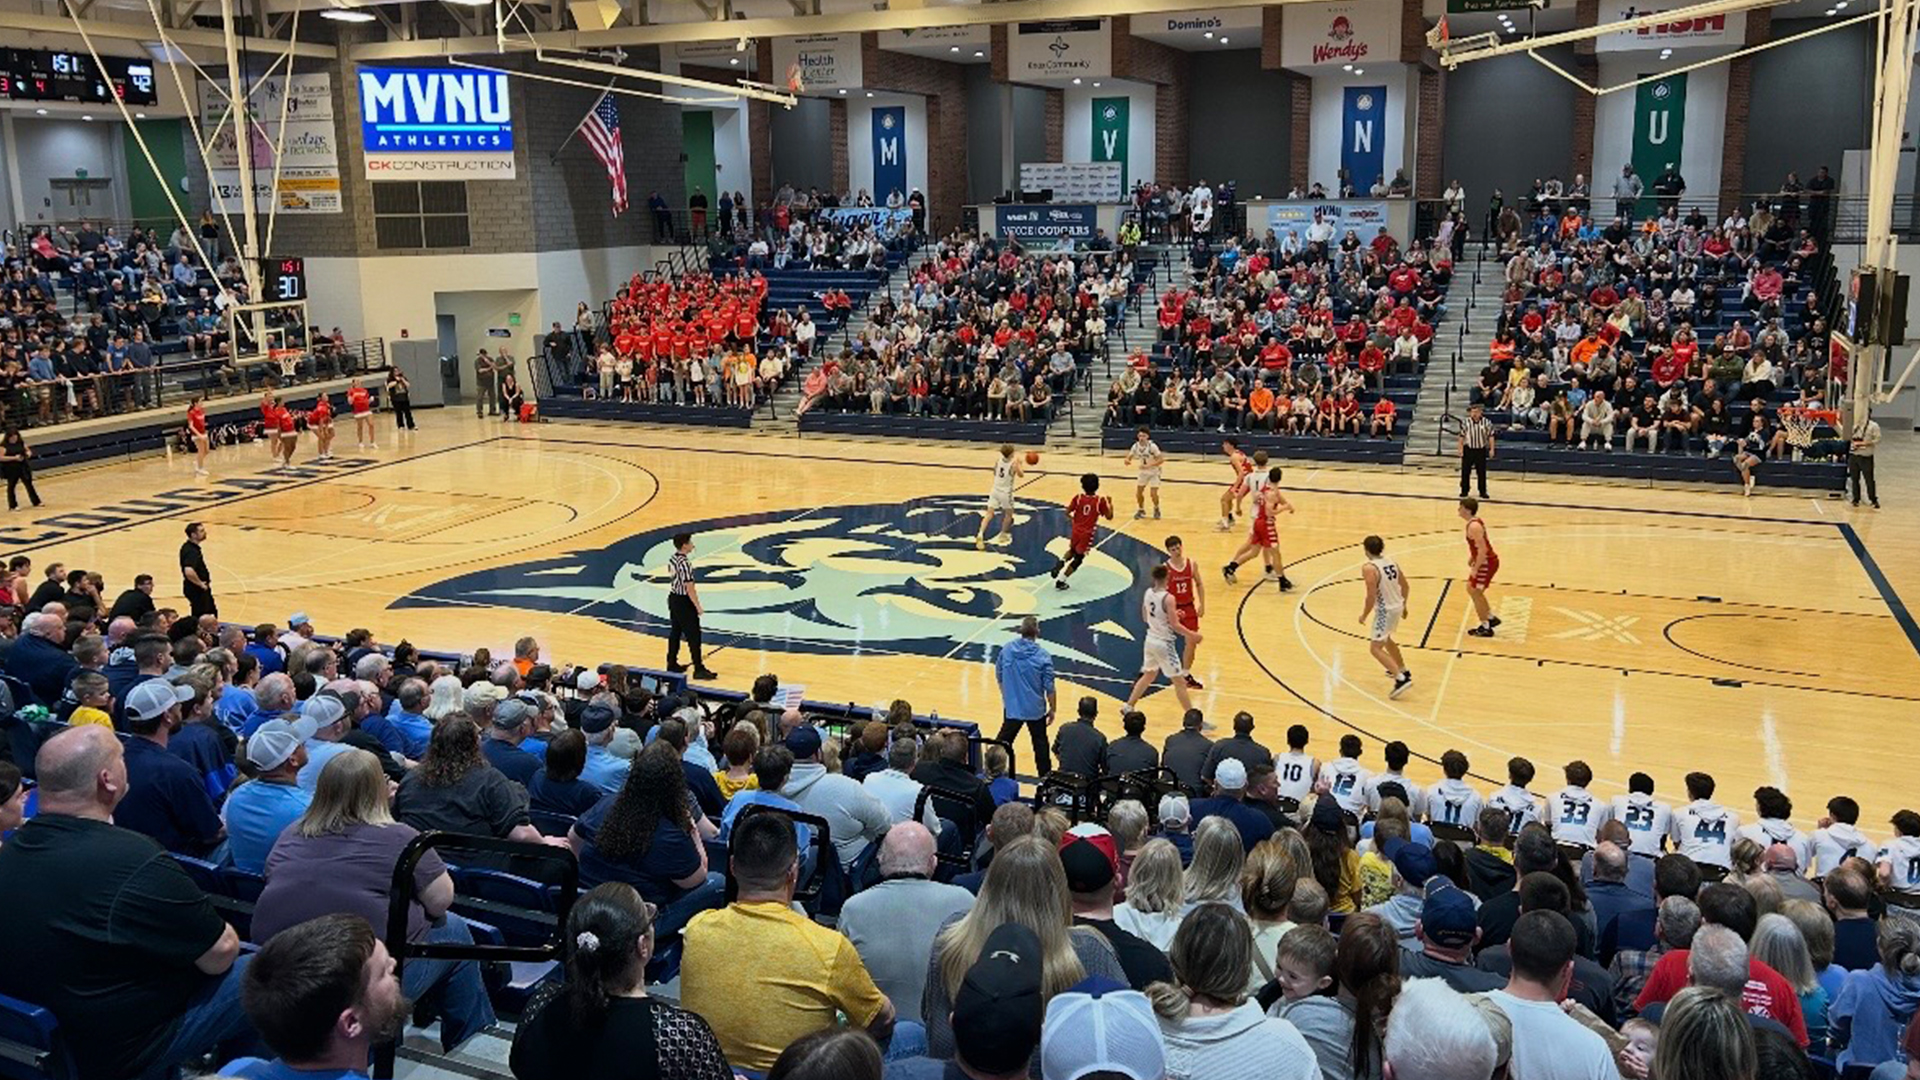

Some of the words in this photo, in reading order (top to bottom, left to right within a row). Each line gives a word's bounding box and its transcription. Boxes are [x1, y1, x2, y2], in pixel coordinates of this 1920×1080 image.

[1168, 16, 1221, 30] Domino's
[798, 53, 834, 66] Health
[1313, 39, 1368, 64] Wendy's
[359, 72, 511, 123] MVNU
[1354, 120, 1372, 152] N
[1649, 110, 1669, 144] U
[378, 135, 500, 146] ATHLETICS
[880, 136, 897, 165] M
[1103, 129, 1117, 160] V
[279, 275, 298, 299] 30
[0, 456, 380, 545] COUGARS
[1082, 504, 1092, 516] 0
[1383, 564, 1397, 581] 55
[1176, 582, 1187, 594] 12
[1283, 763, 1302, 782] 10
[1332, 773, 1357, 797] 12
[1560, 800, 1591, 826] 33
[1624, 805, 1655, 832] 23
[1693, 818, 1727, 845] 44
